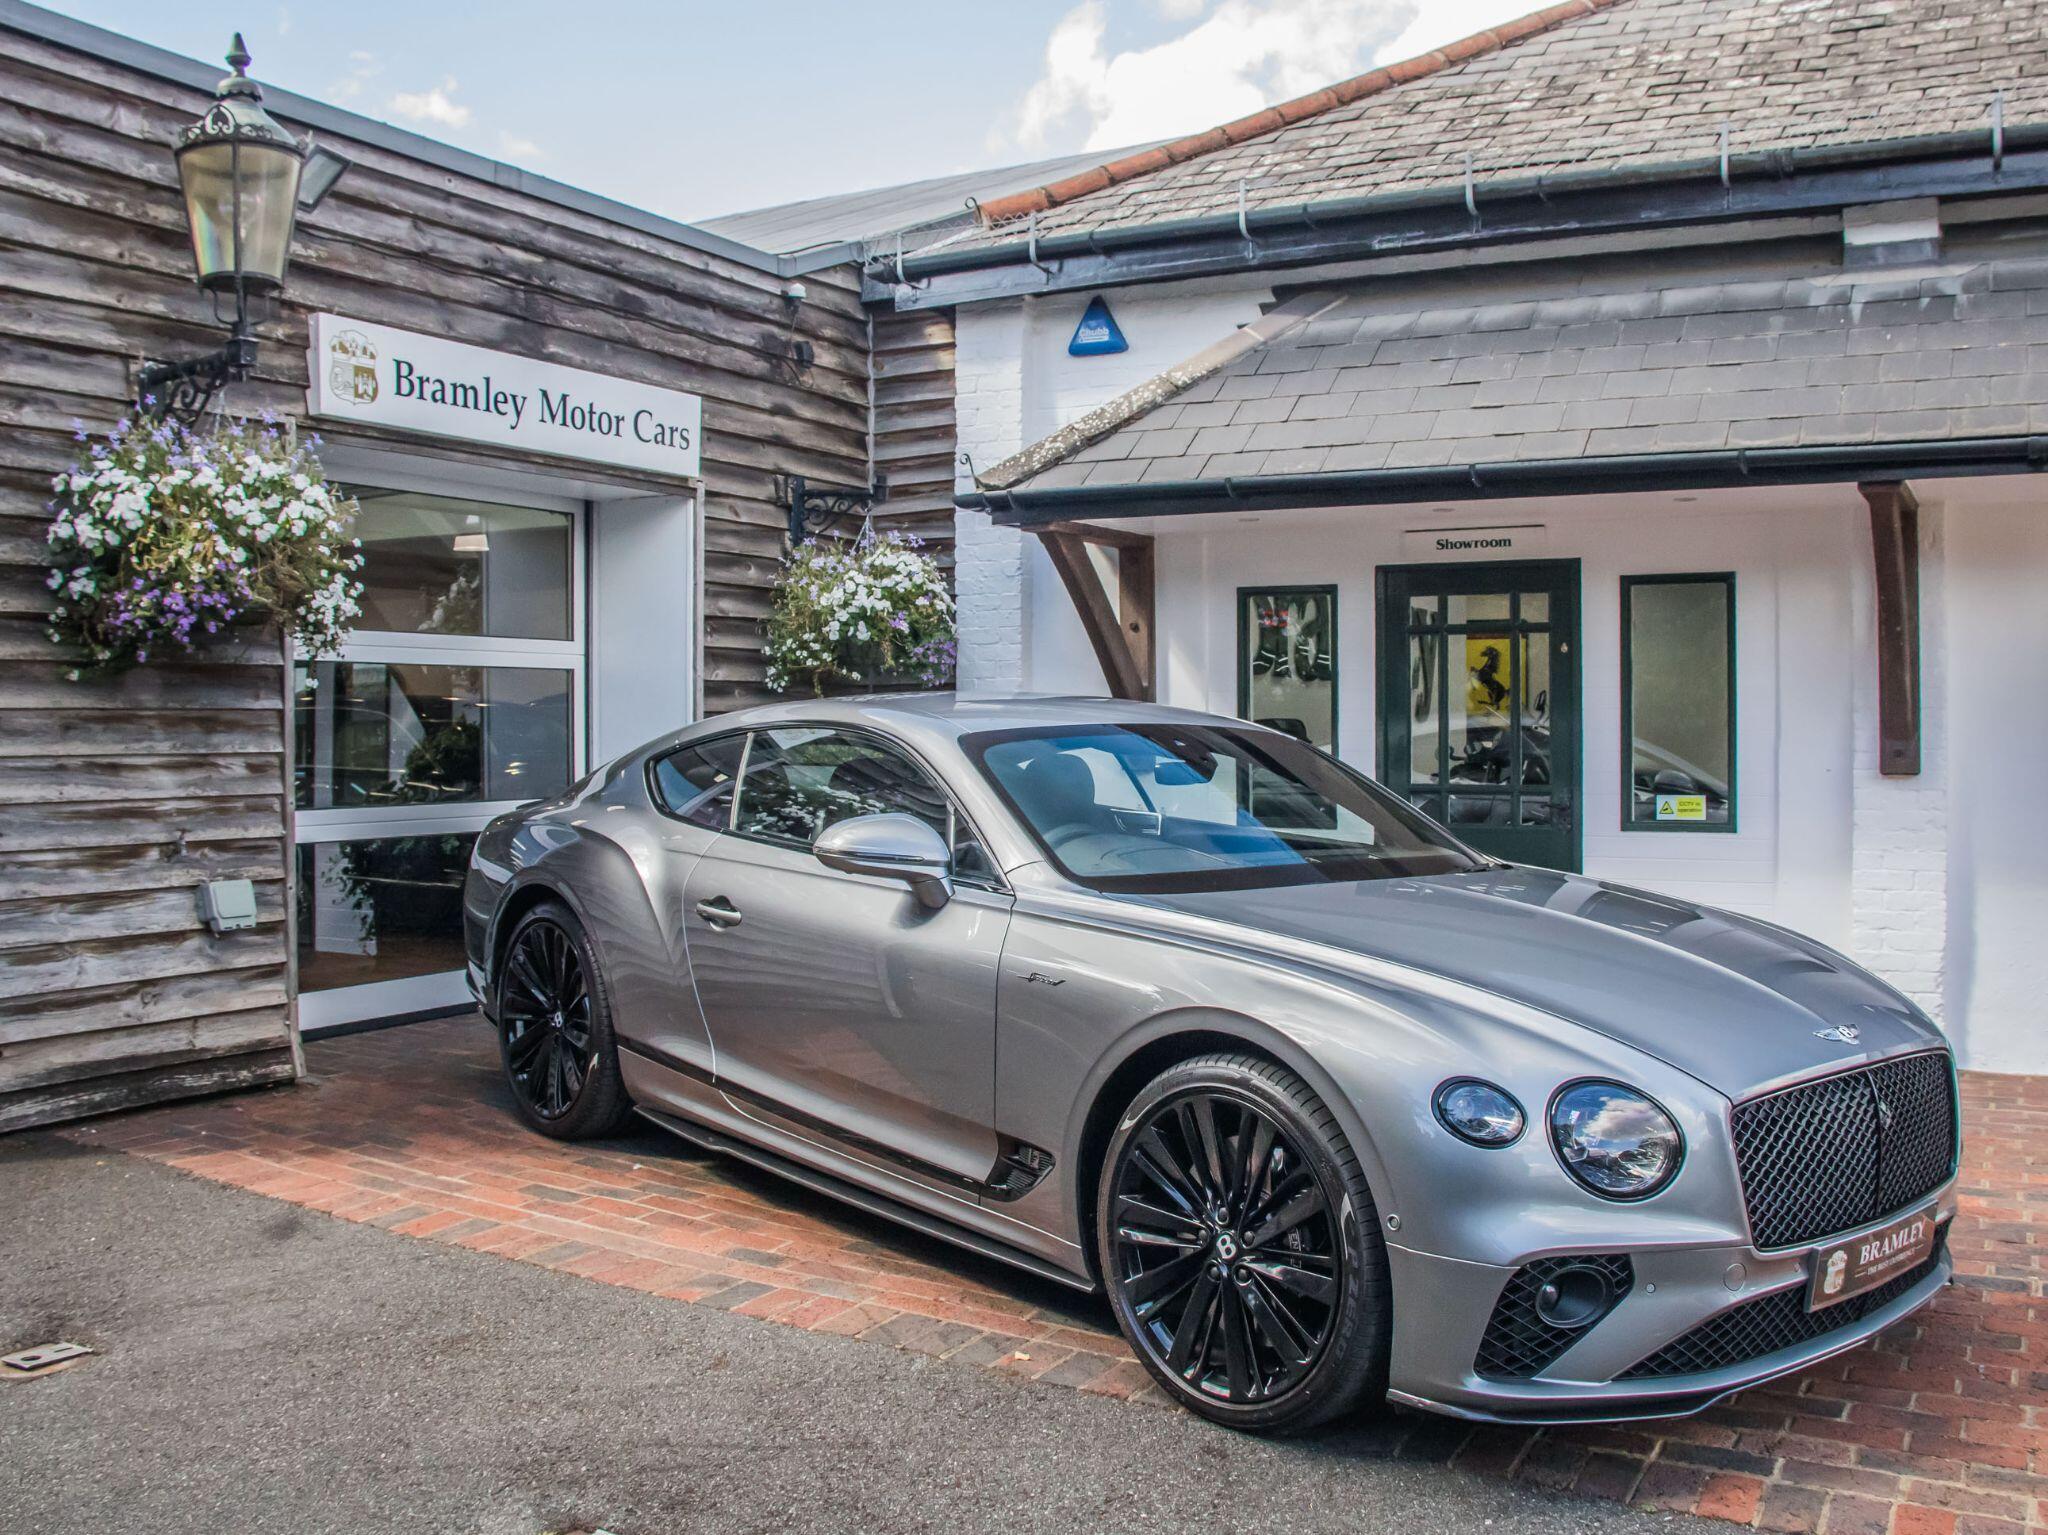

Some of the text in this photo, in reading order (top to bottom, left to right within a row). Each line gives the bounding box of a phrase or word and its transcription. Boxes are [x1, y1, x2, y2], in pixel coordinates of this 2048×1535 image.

[392, 358, 691, 451] Bramley Motor Cars
[1436, 538, 1512, 550] Showroom
[1216, 1234, 1237, 1260] B
[1860, 1221, 1925, 1265] BRAMLEY
